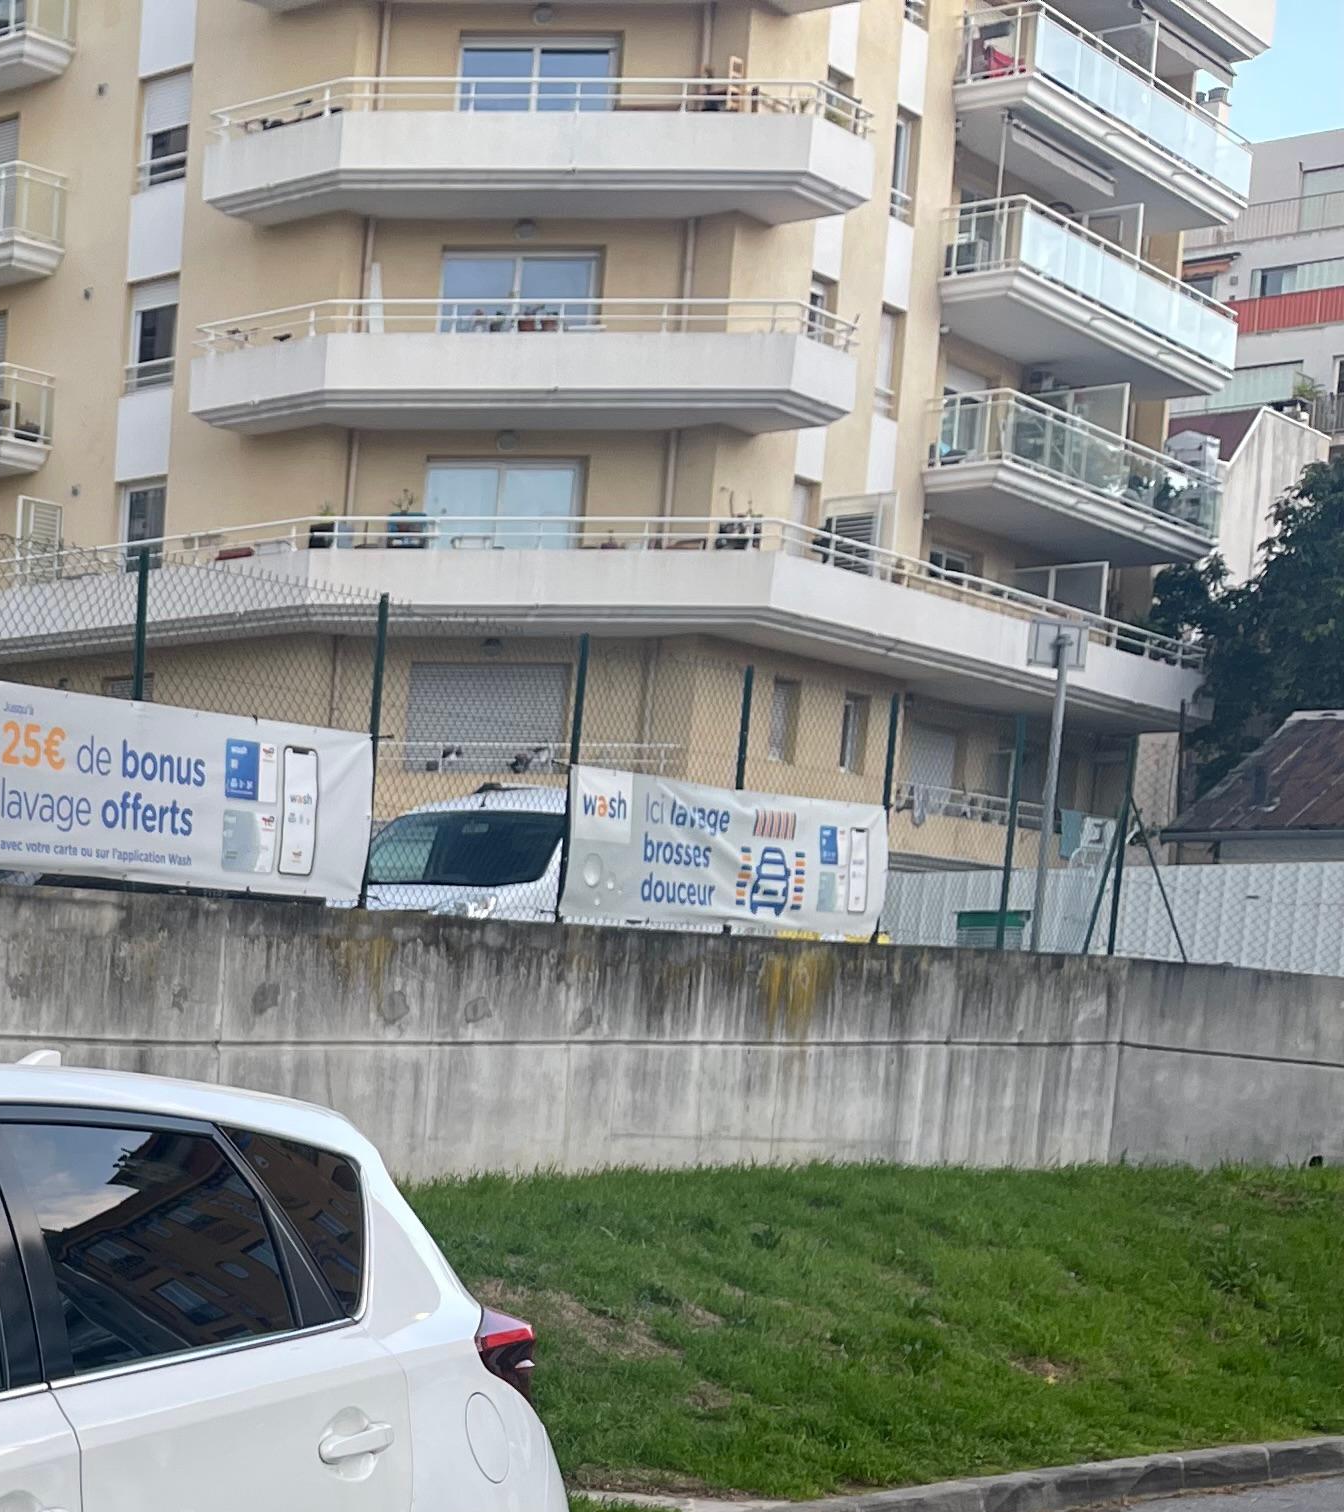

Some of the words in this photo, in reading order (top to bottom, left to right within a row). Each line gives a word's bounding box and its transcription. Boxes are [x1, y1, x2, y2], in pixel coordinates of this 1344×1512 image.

[1, 719, 67, 771] 25€
[77, 735, 112, 776] de
[122, 738, 206, 787] bonus
[0, 776, 92, 832] lavage
[101, 790, 193, 836] offerts
[582, 791, 627, 821] wash
[645, 792, 665, 825] Ici
[0, 839, 23, 851] avec
[26, 841, 51, 855] votre
[53, 843, 78, 857] carte
[81, 848, 93, 858] ou
[95, 849, 110, 860] sur
[112, 847, 166, 865] l'application
[168, 853, 192, 866] Wash
[643, 831, 712, 868] brosses
[641, 871, 716, 906] douceur
